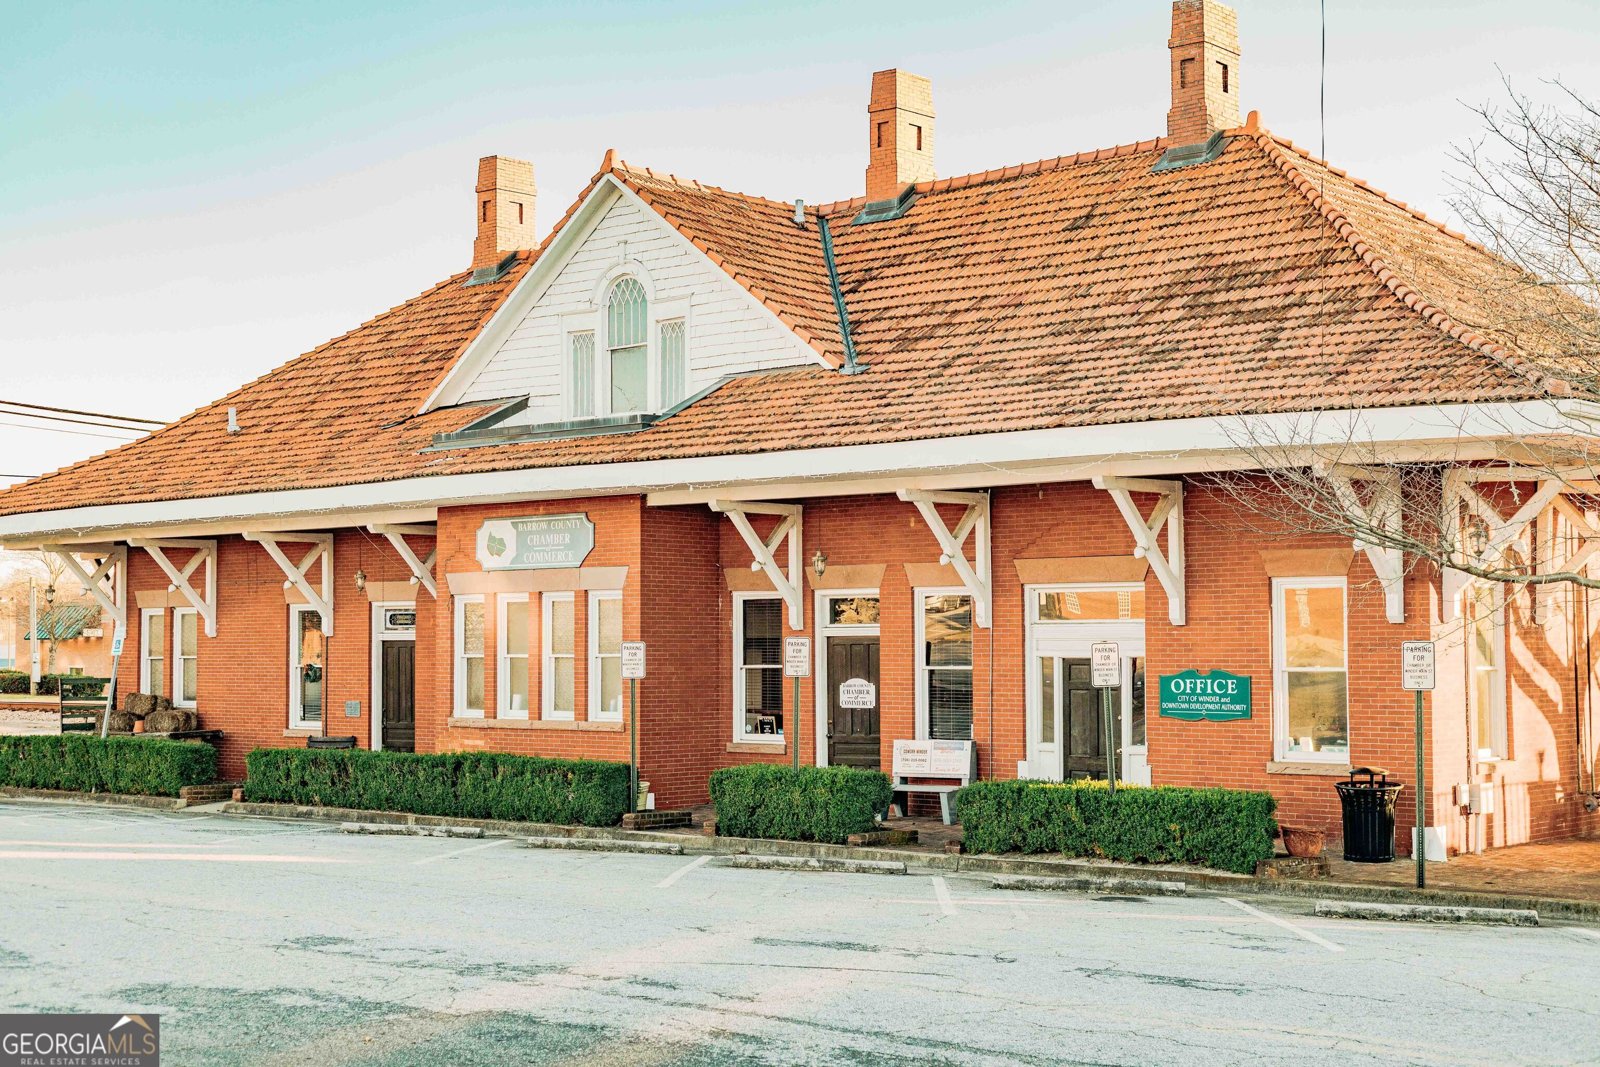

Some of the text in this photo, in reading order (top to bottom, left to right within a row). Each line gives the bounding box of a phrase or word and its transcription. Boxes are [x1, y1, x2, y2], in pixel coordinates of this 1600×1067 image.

[518, 520, 581, 532] BARROW COUNTY
[527, 533, 570, 546] CHAMBER
[524, 550, 574, 563] COMMERCE
[1170, 678, 1238, 694] OFFICE
